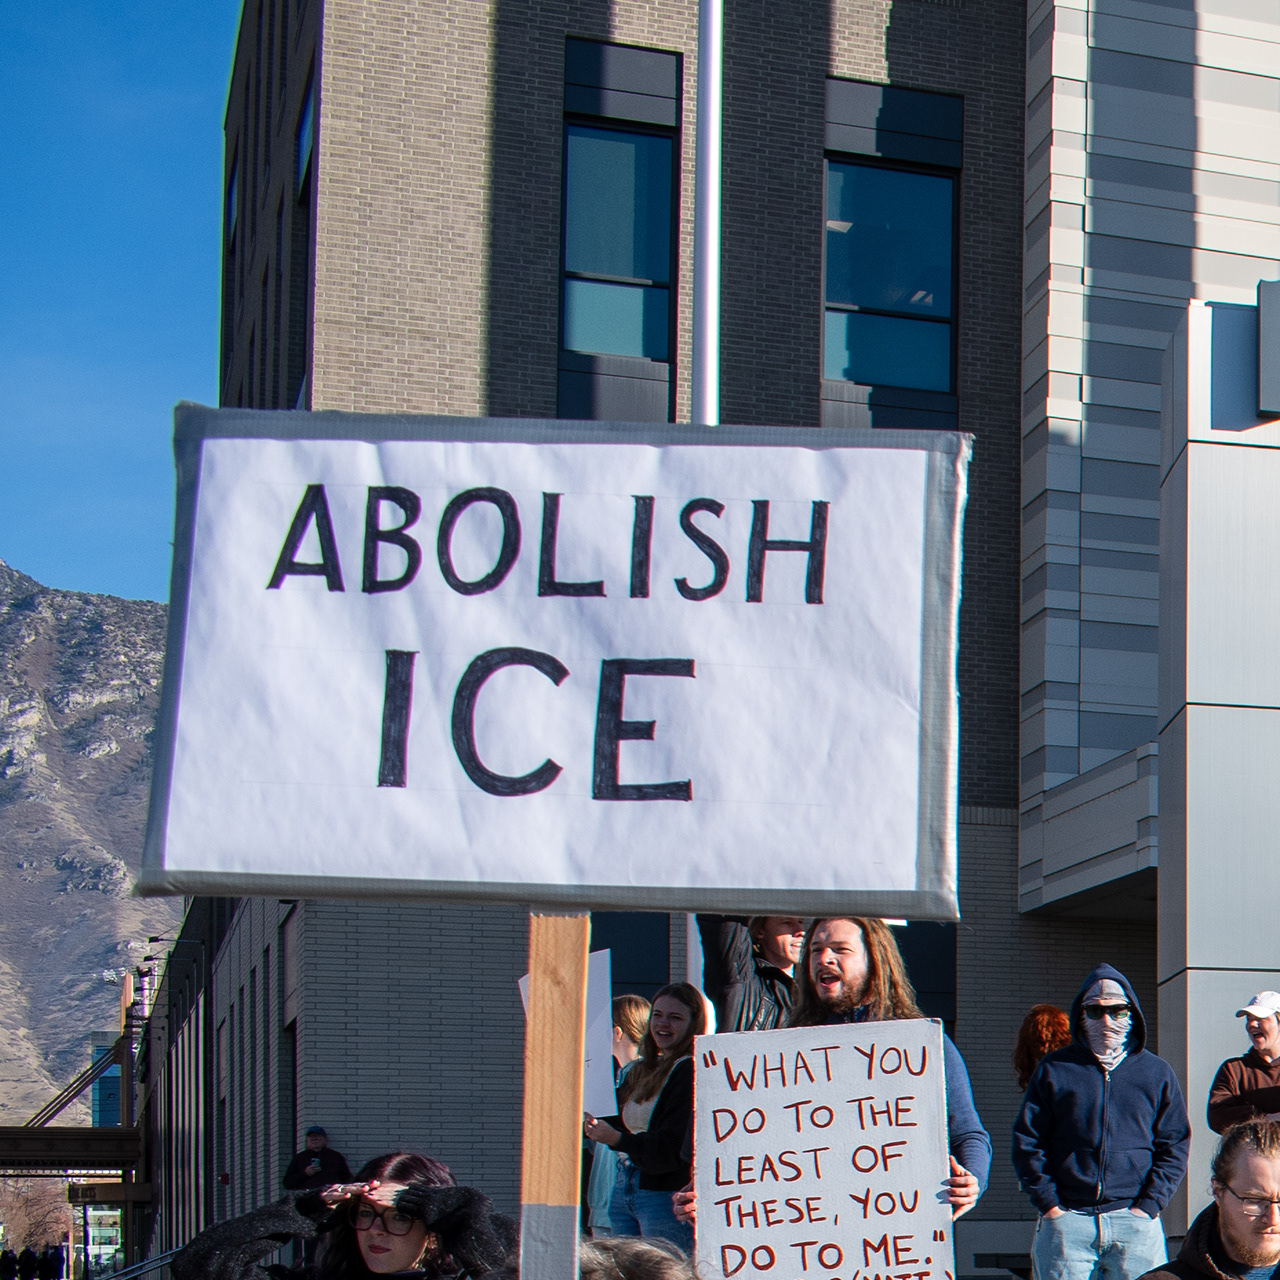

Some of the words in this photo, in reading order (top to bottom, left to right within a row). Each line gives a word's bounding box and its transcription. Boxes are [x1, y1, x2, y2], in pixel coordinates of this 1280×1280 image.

[265, 483, 830, 605] ABOLISH
[376, 645, 697, 802] ICE
[702, 1046, 840, 1091] "WHAT
[854, 1043, 927, 1080] YOU
[712, 1107, 766, 1143] DO
[783, 1100, 834, 1133] TO
[846, 1096, 918, 1131] THE
[714, 1146, 830, 1186] LEAST
[851, 1141, 908, 1173] OF
[714, 1195, 839, 1228] THESE,
[849, 1187, 920, 1220] YOU
[720, 1244, 776, 1278] DO
[789, 1241, 844, 1271] TO
[863, 1229, 945, 1268] ME."
